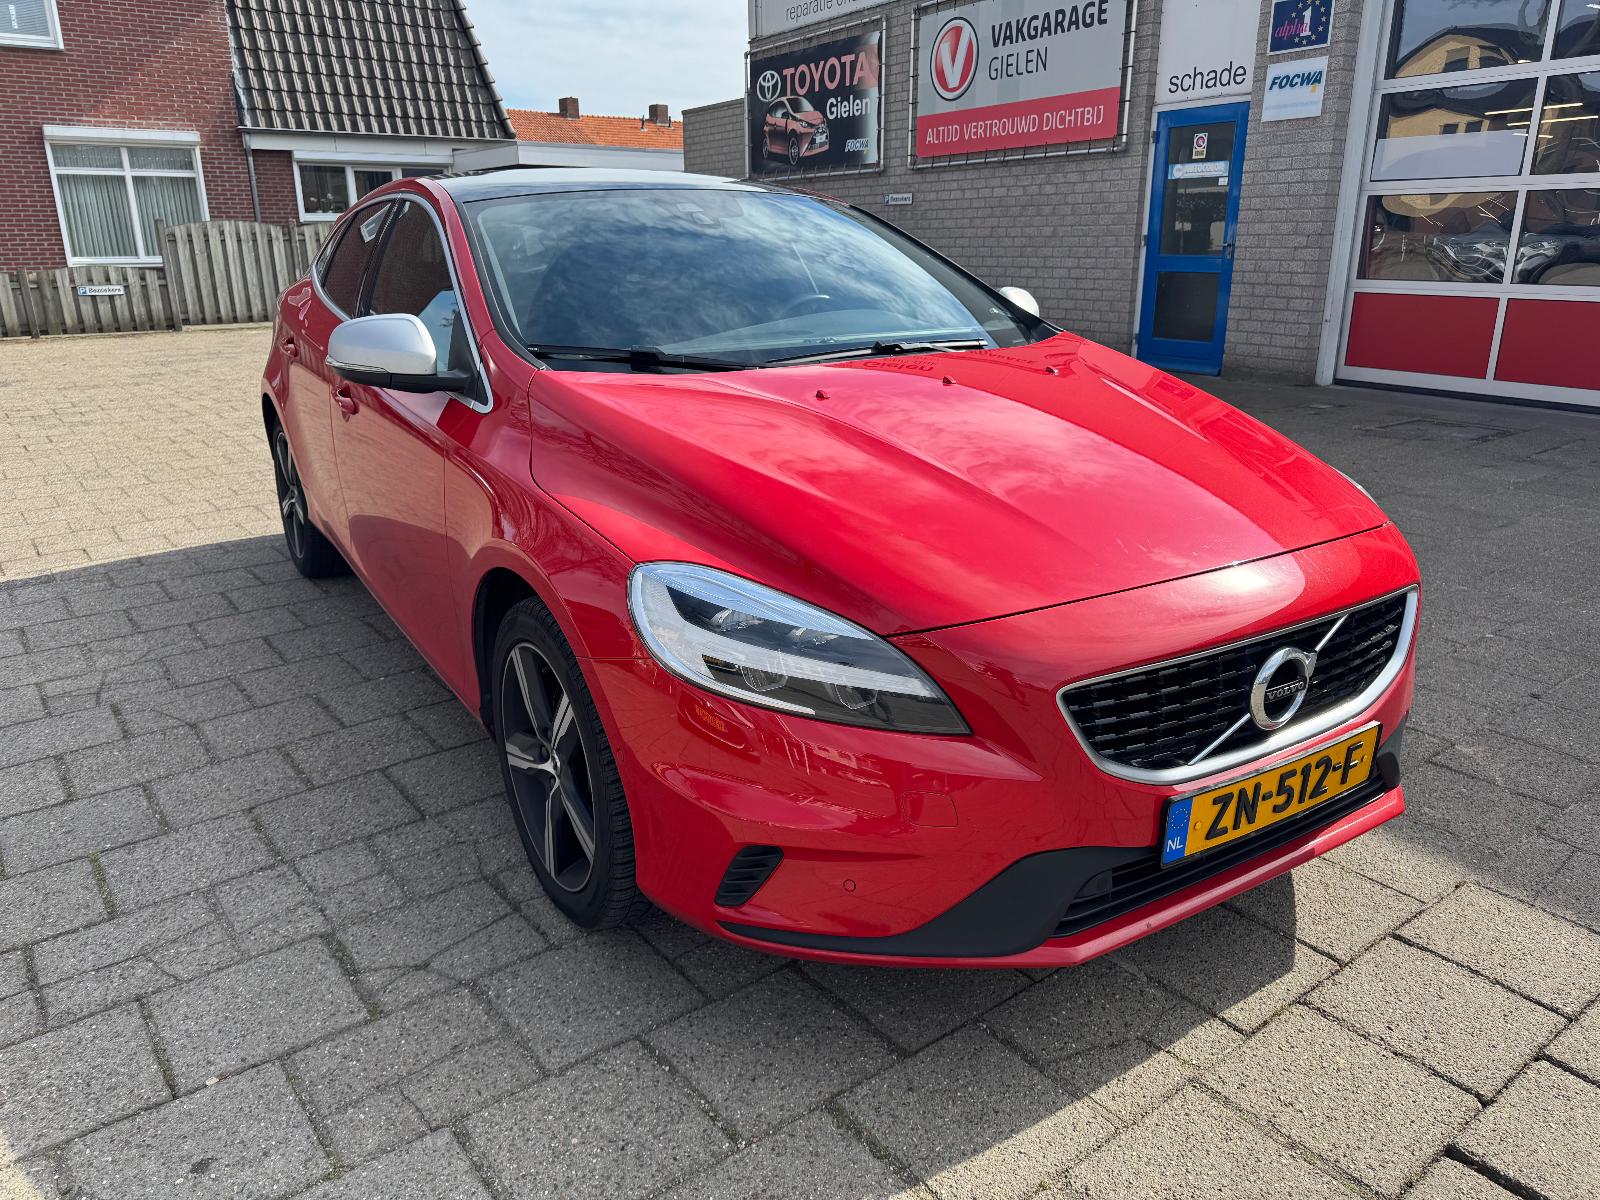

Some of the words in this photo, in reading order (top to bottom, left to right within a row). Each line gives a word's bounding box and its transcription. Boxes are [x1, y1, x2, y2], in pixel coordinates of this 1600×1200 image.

[785, 0, 833, 23] reparatie
[991, 0, 1108, 48] VAKGARAGE
[1275, 18, 1308, 40] alpha
[1300, 6, 1312, 37] 1
[782, 50, 870, 97] TOYOTA
[988, 46, 1048, 81] GIELEN
[1168, 61, 1247, 94] schade
[1268, 70, 1324, 91] FOCWA
[826, 95, 870, 119] Gielen
[926, 124, 960, 145] ALTIJD
[963, 114, 1039, 140] VERTROUWD
[1043, 105, 1104, 131] DICHTBIJ
[845, 138, 869, 151] FOCWA
[1266, 681, 1305, 700] VOLVO
[1204, 741, 1365, 841] ZN-512-F
[1166, 836, 1184, 853] NL
